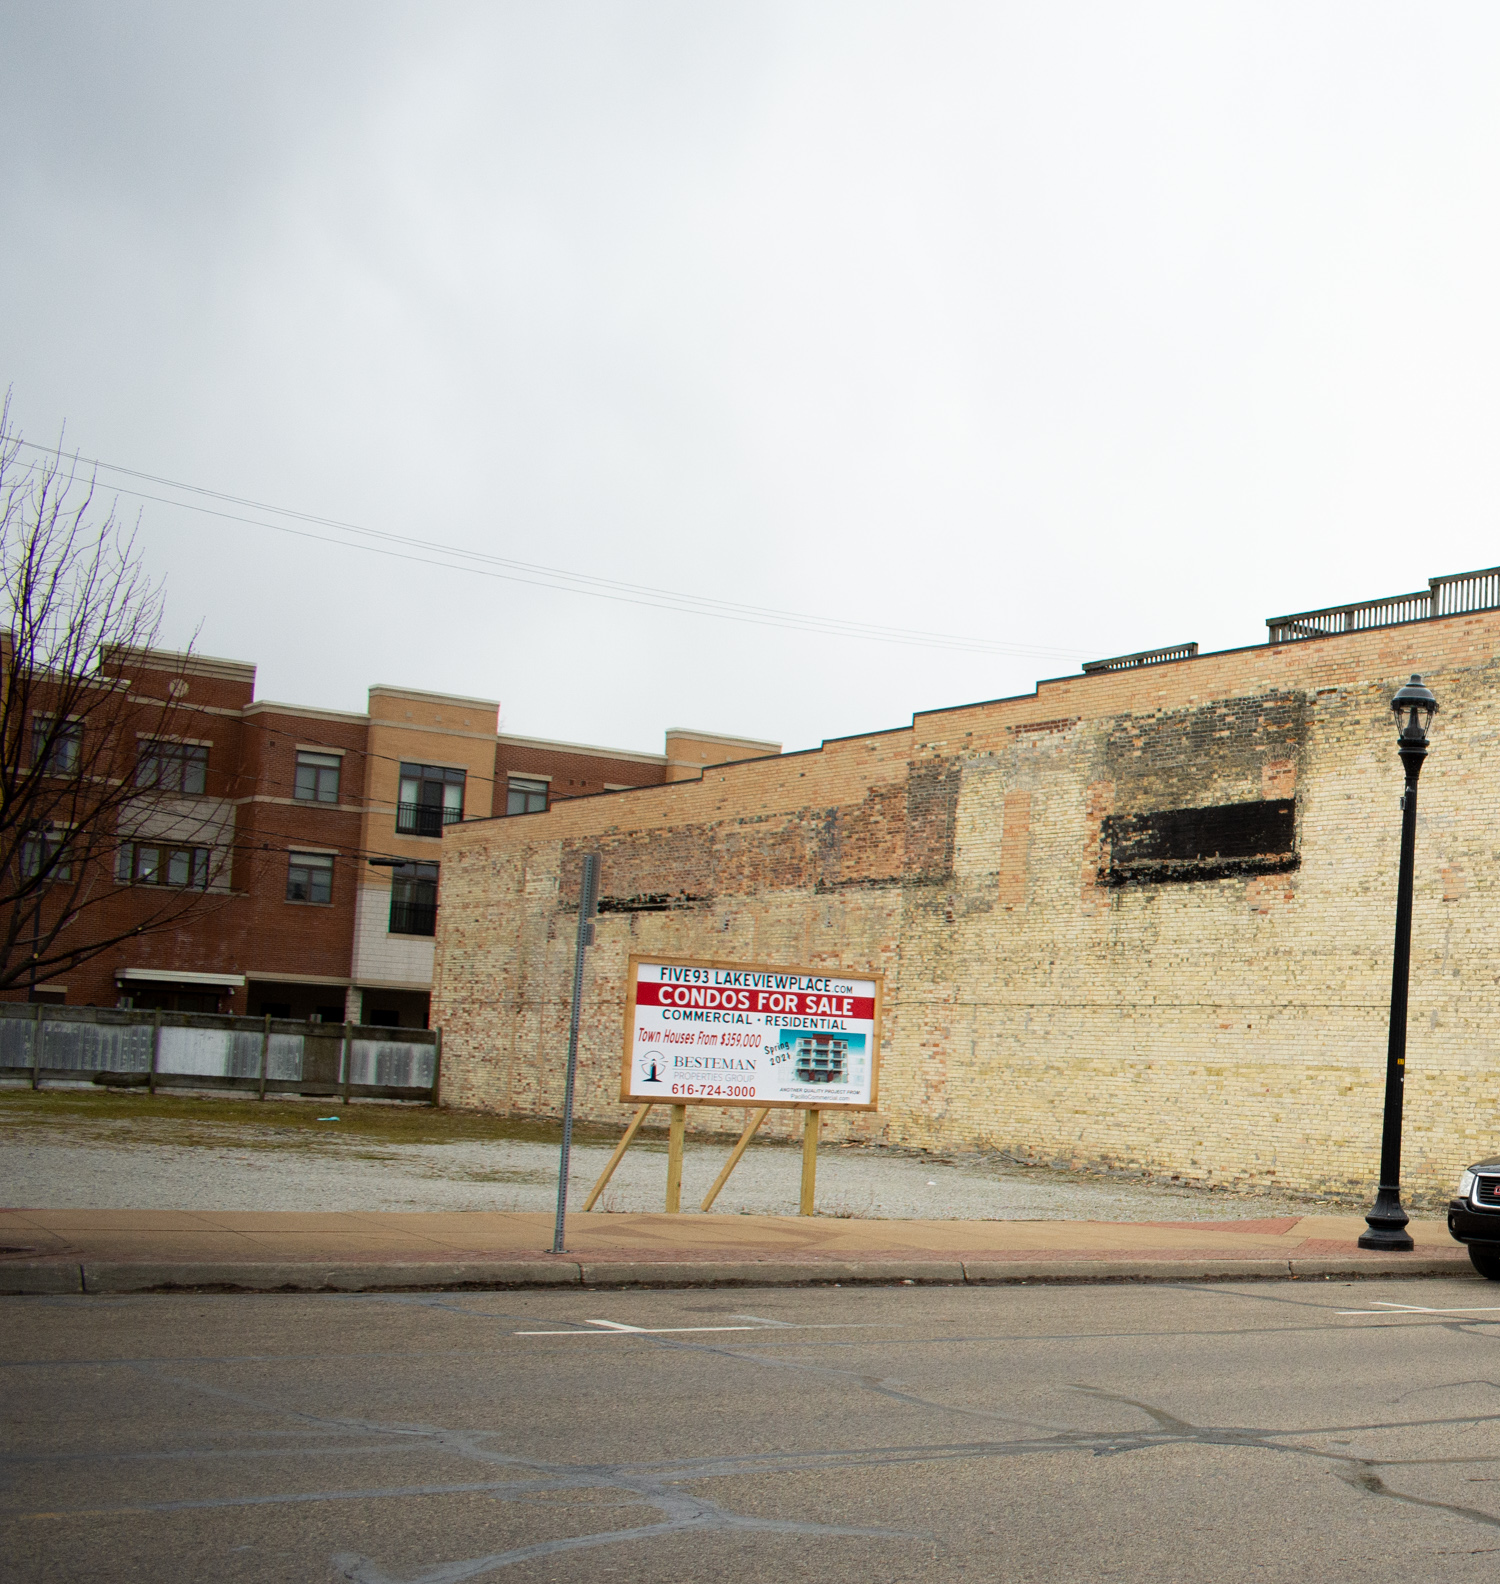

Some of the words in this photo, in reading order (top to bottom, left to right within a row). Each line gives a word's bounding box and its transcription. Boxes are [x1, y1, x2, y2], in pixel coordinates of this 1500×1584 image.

[660, 967, 709, 983] FIVE93
[658, 986, 750, 1009] CONDOS
[757, 992, 799, 1012] FOR
[805, 996, 854, 1016] SALE
[662, 1009, 753, 1025] COMMERCIAL
[765, 1015, 847, 1030] RESIDENTIAL
[638, 1027, 661, 1043] Town
[663, 1029, 695, 1045] Houses
[697, 1031, 718, 1046] From
[720, 1032, 762, 1048] $359,000
[764, 1041, 790, 1055] Spring
[673, 1055, 757, 1070] BESTEMAN
[770, 1052, 791, 1066] 2021
[673, 1071, 723, 1082] PROPERTIES
[724, 1073, 755, 1083] GROUP
[671, 1083, 756, 1098] 616-724-3000
